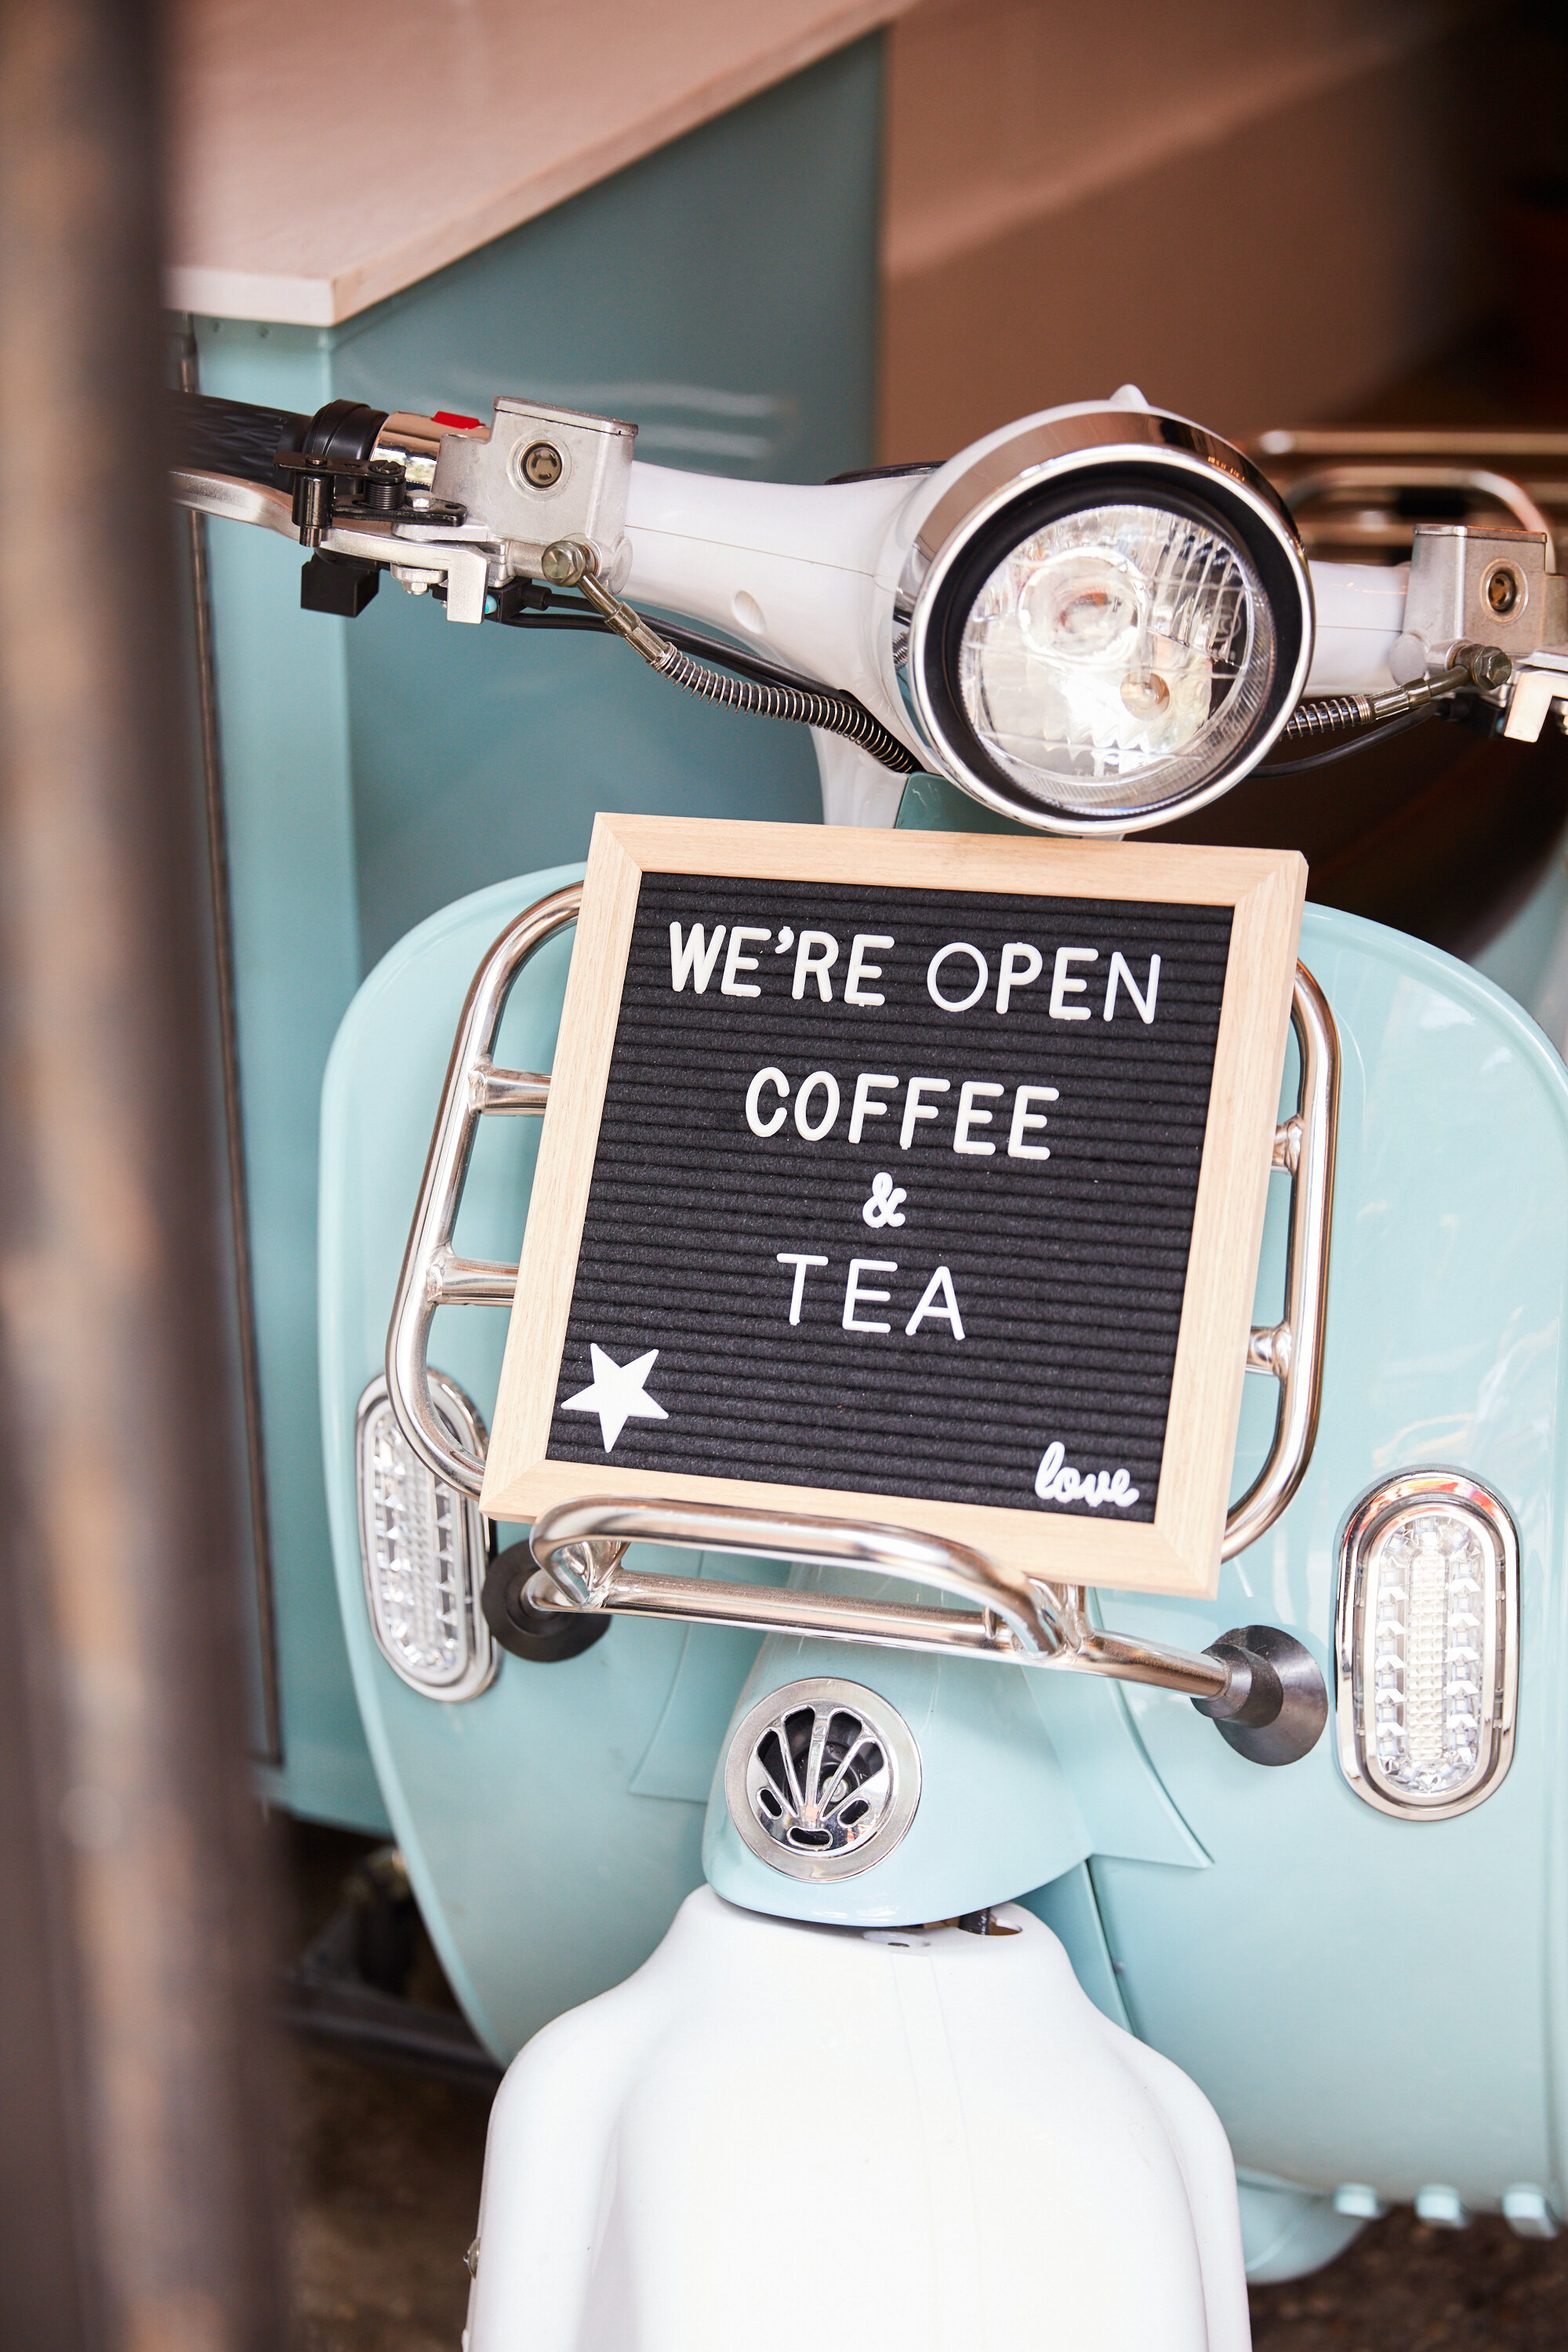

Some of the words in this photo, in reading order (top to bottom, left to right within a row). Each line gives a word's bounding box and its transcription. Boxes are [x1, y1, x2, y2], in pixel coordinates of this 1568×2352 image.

[670, 921, 895, 1007] WE'RE
[927, 942, 1160, 1024] OPEN
[746, 1067, 1059, 1160] COFFEE
[862, 1172, 907, 1229] &
[777, 1253, 965, 1341] TEA
[1035, 1441, 1139, 1508] love
